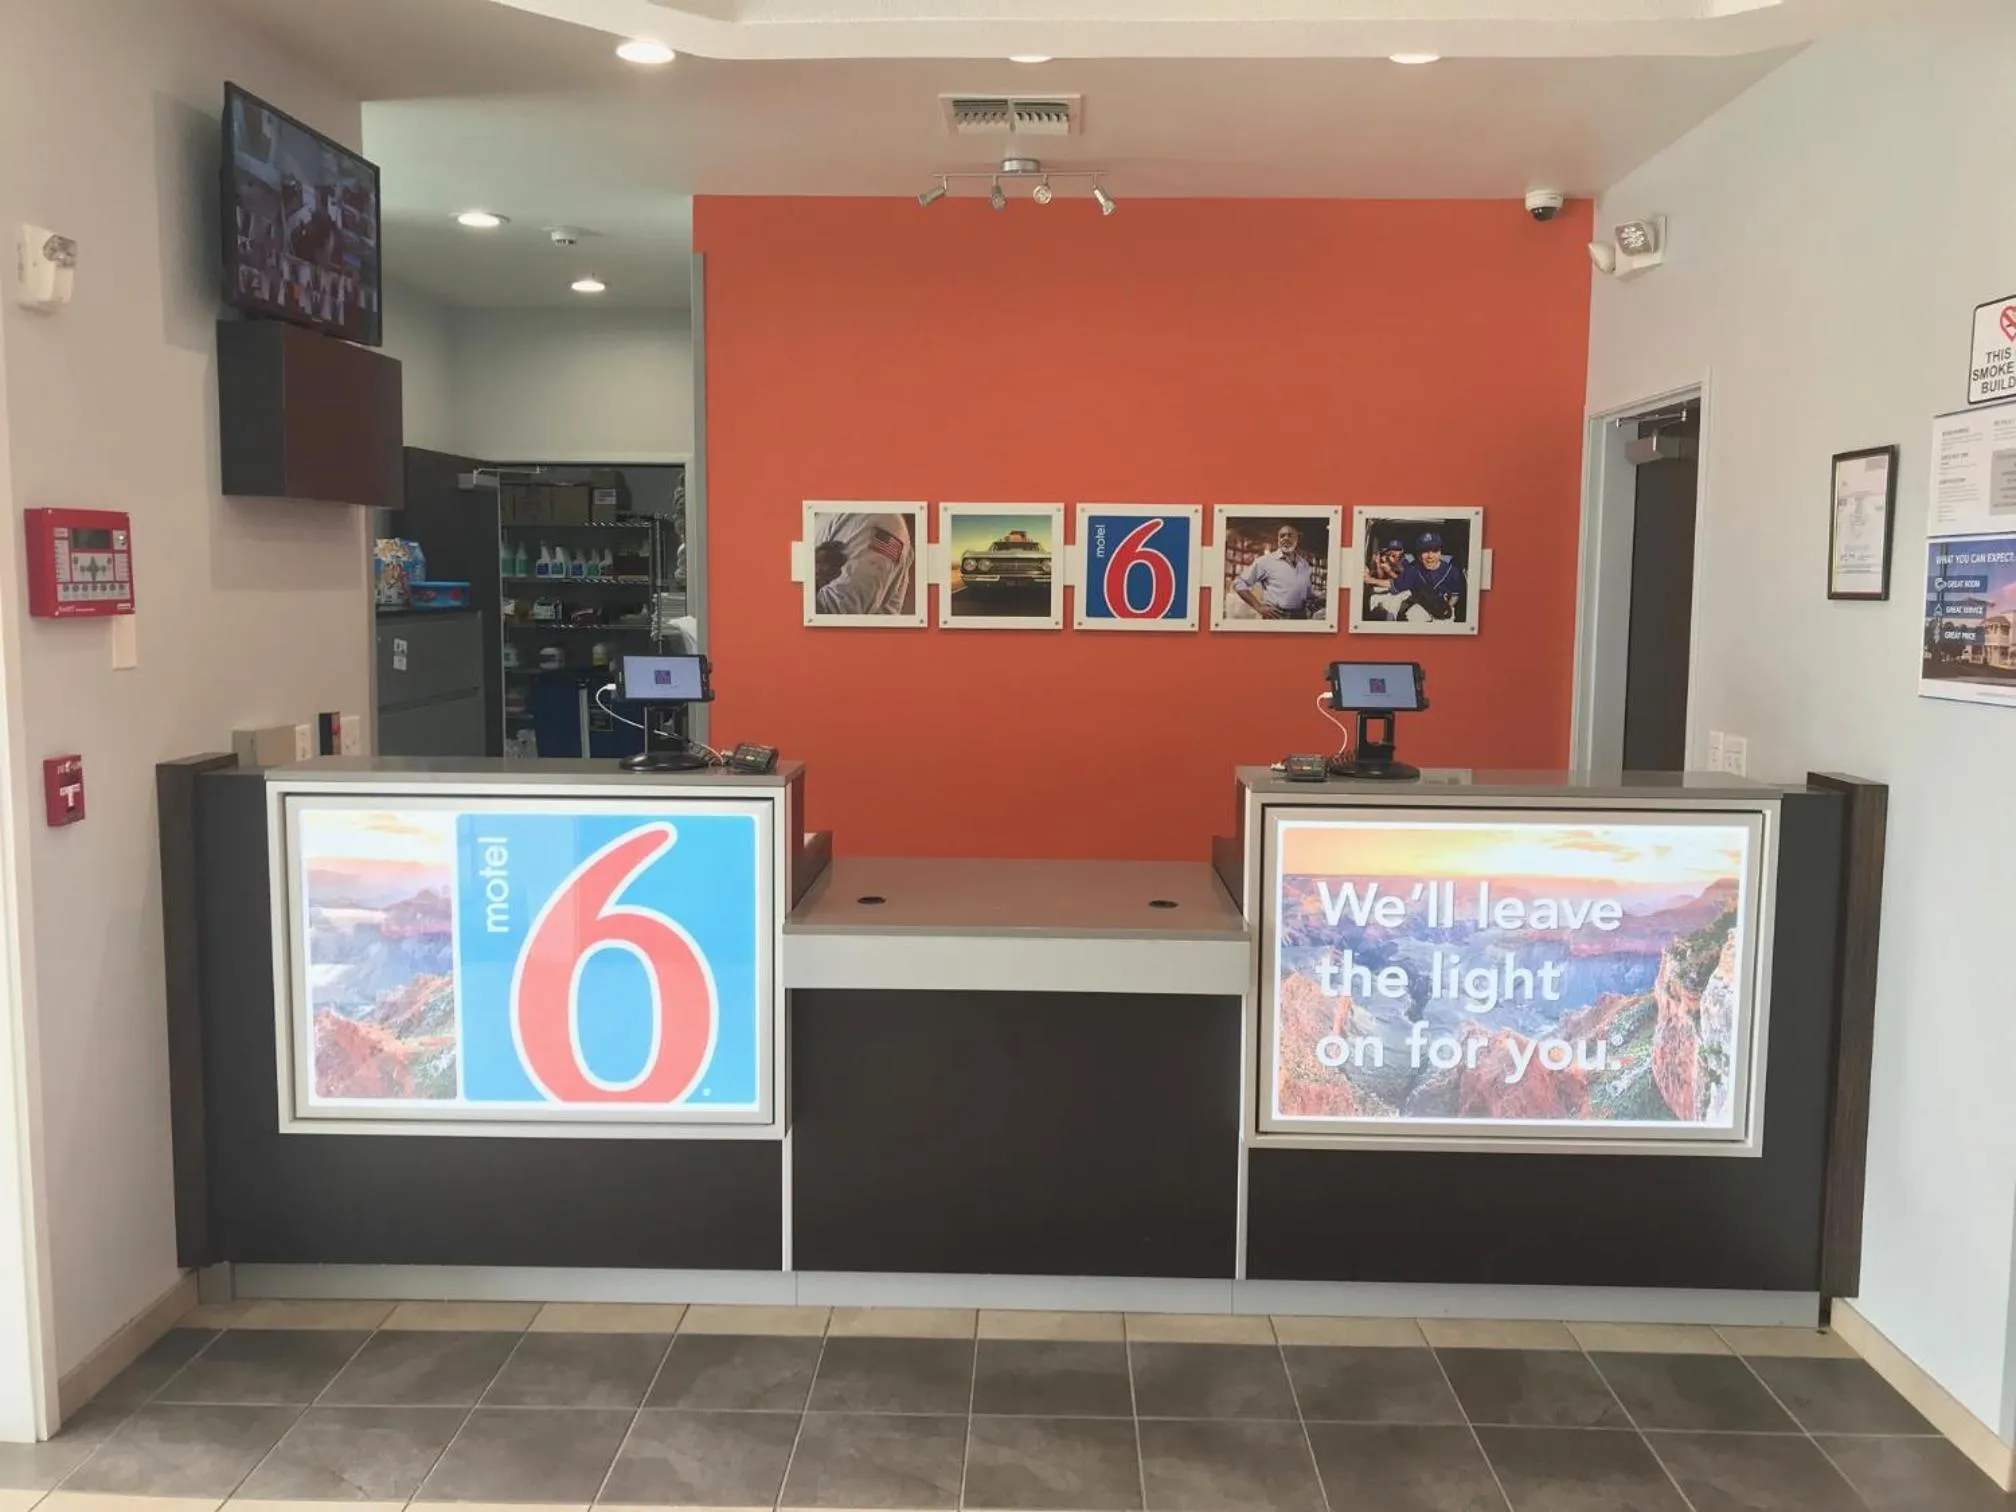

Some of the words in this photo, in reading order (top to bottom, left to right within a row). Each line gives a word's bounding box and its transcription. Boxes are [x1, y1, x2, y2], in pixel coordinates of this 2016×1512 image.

[1973, 361, 2015, 381] SMOKE
[1986, 347, 2012, 363] THIS
[1095, 524, 1106, 558] motel
[1936, 554, 1954, 565] WHAT
[1956, 554, 1970, 564] YOU
[1971, 553, 1986, 563] CAN
[1104, 518, 1175, 620] 6
[478, 836, 510, 933] motel
[1316, 880, 1455, 929] We'll
[1478, 881, 1624, 931] leave
[510, 821, 719, 1104] 6
[1317, 950, 1409, 998] the
[1432, 952, 1565, 1012] light
[1316, 1034, 1384, 1069] on
[1410, 1021, 1489, 1070] for
